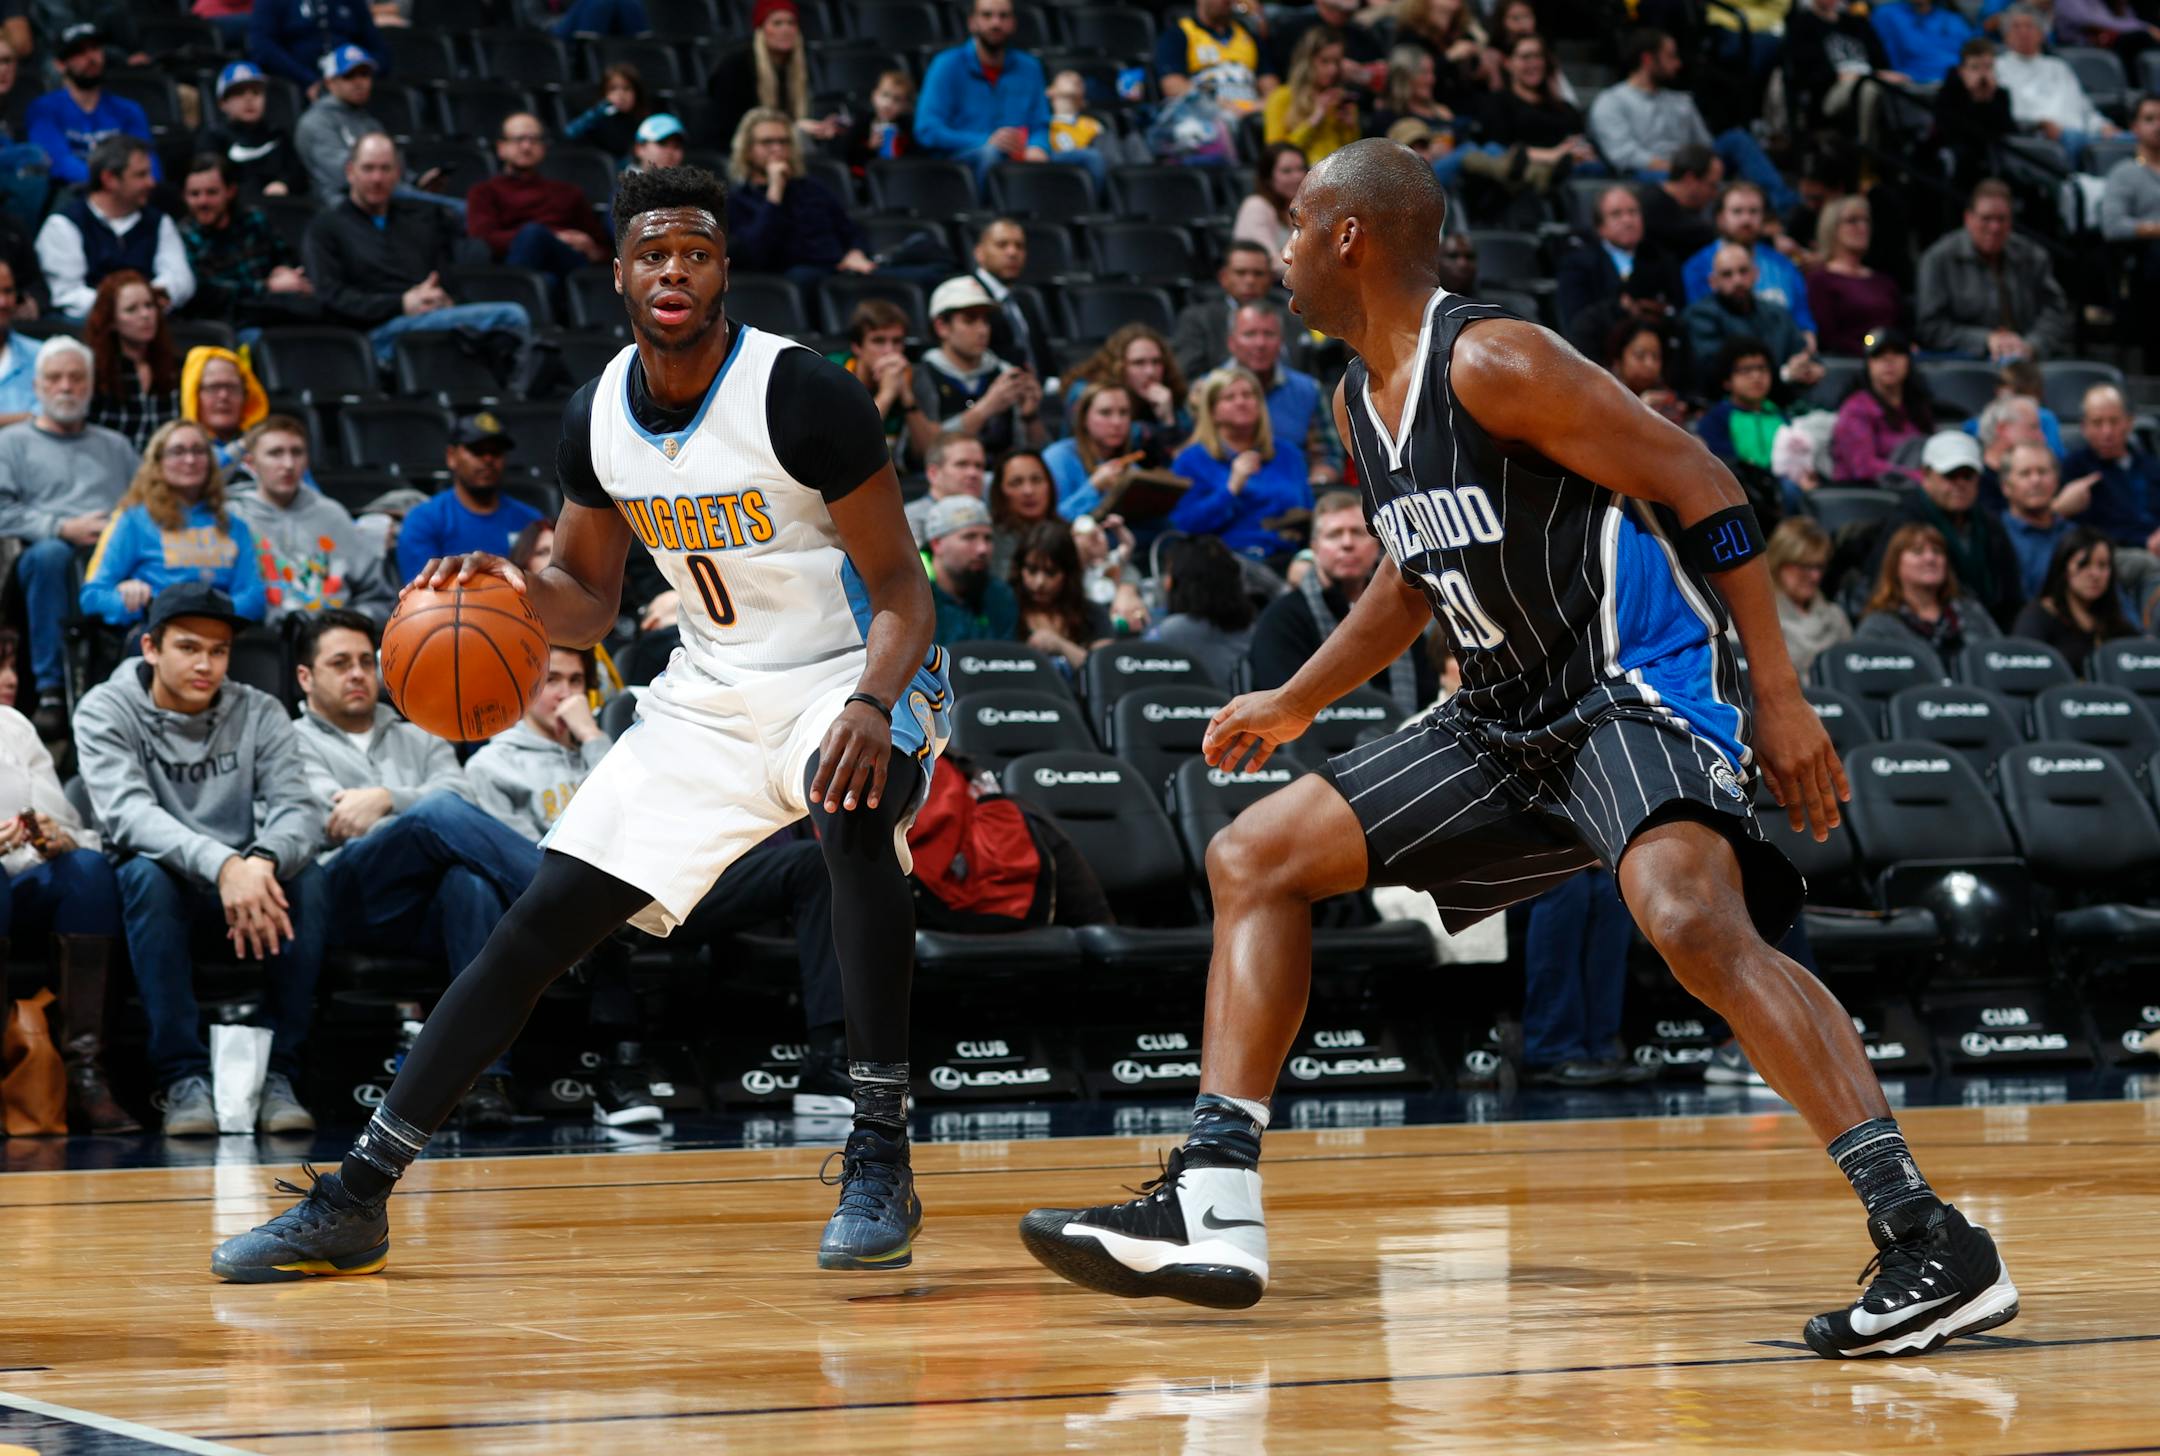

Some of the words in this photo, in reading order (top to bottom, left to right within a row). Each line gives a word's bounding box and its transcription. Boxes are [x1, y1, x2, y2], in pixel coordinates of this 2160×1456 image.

[1707, 519, 1751, 563] 20
[685, 554, 737, 627] 0
[1421, 569, 1505, 650] 20
[980, 659, 1036, 671] LEXUS
[1000, 709, 1060, 722] LEXUS
[1327, 707, 1386, 720] LEXUS
[1893, 759, 1951, 773] LEXUS
[1058, 770, 1121, 783] LEXUS
[1981, 1007, 2029, 1026] CLUB
[1136, 1032, 1188, 1051] CLUB
[1314, 1029, 1366, 1048] CLUB
[1989, 1033, 2068, 1051] LEXUS
[771, 1044, 811, 1060] CLU
[956, 1040, 1009, 1057] CLUB
[1662, 1047, 1714, 1064] LEX
[1144, 1062, 1202, 1078] LEX
[1321, 1056, 1406, 1075] LEXUS
[961, 1067, 1051, 1086] LEXUS
